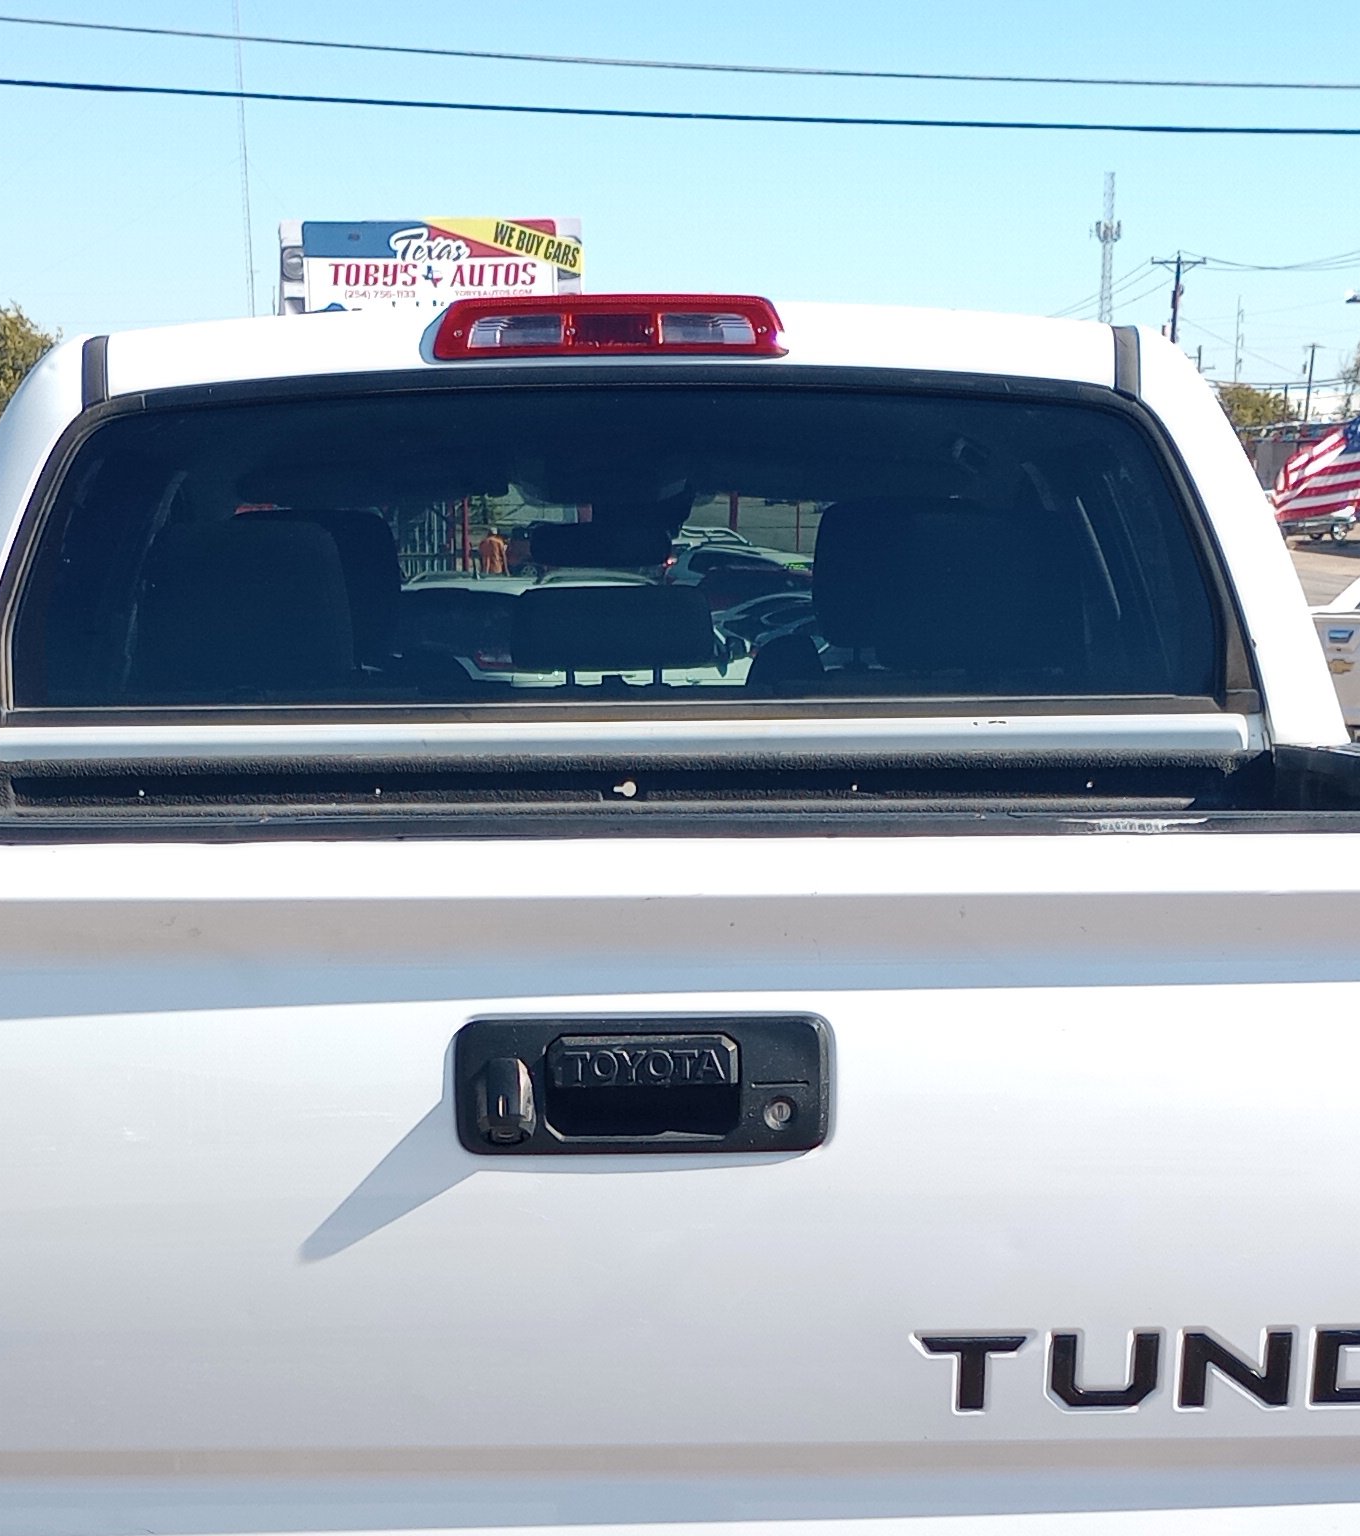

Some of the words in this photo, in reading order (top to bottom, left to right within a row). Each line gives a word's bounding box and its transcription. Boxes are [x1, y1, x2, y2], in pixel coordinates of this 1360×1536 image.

[394, 231, 466, 262] Texas
[493, 221, 515, 247] WE
[515, 228, 544, 255] BUY
[543, 236, 580, 269] CARS
[329, 261, 418, 287] TOBY'S
[450, 261, 537, 287] AUTOS
[344, 290, 371, 299] (254)
[563, 1049, 727, 1084] TOYOTA
